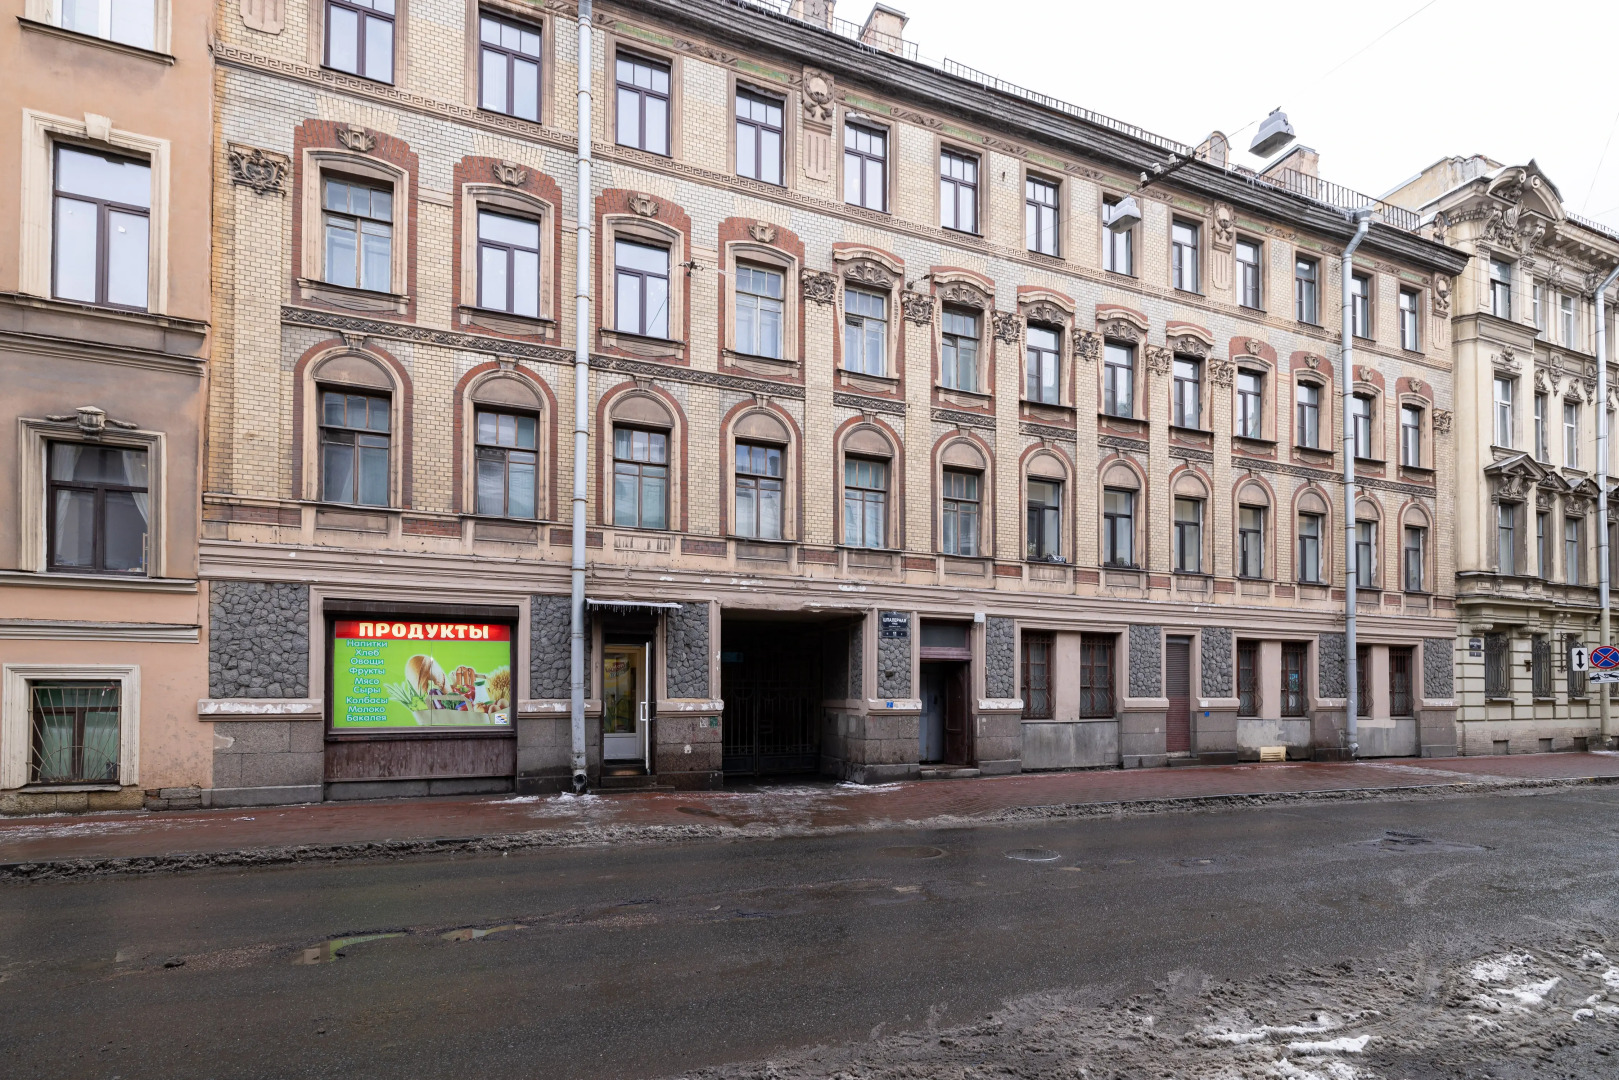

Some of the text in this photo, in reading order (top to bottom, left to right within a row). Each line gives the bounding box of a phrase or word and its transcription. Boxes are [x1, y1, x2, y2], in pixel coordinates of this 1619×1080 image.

[359, 622, 489, 639] ПРОДУКТЫ
[346, 639, 388, 648] Напитки
[355, 648, 380, 657] Хлеб
[350, 657, 385, 666] Овощи
[349, 667, 385, 676] Фрукты
[354, 677, 380, 685] Мясо
[353, 686, 381, 695] Сыры
[346, 696, 388, 704] Колбасы
[348, 705, 386, 713] Молоко
[346, 714, 387, 722] Бакалея
